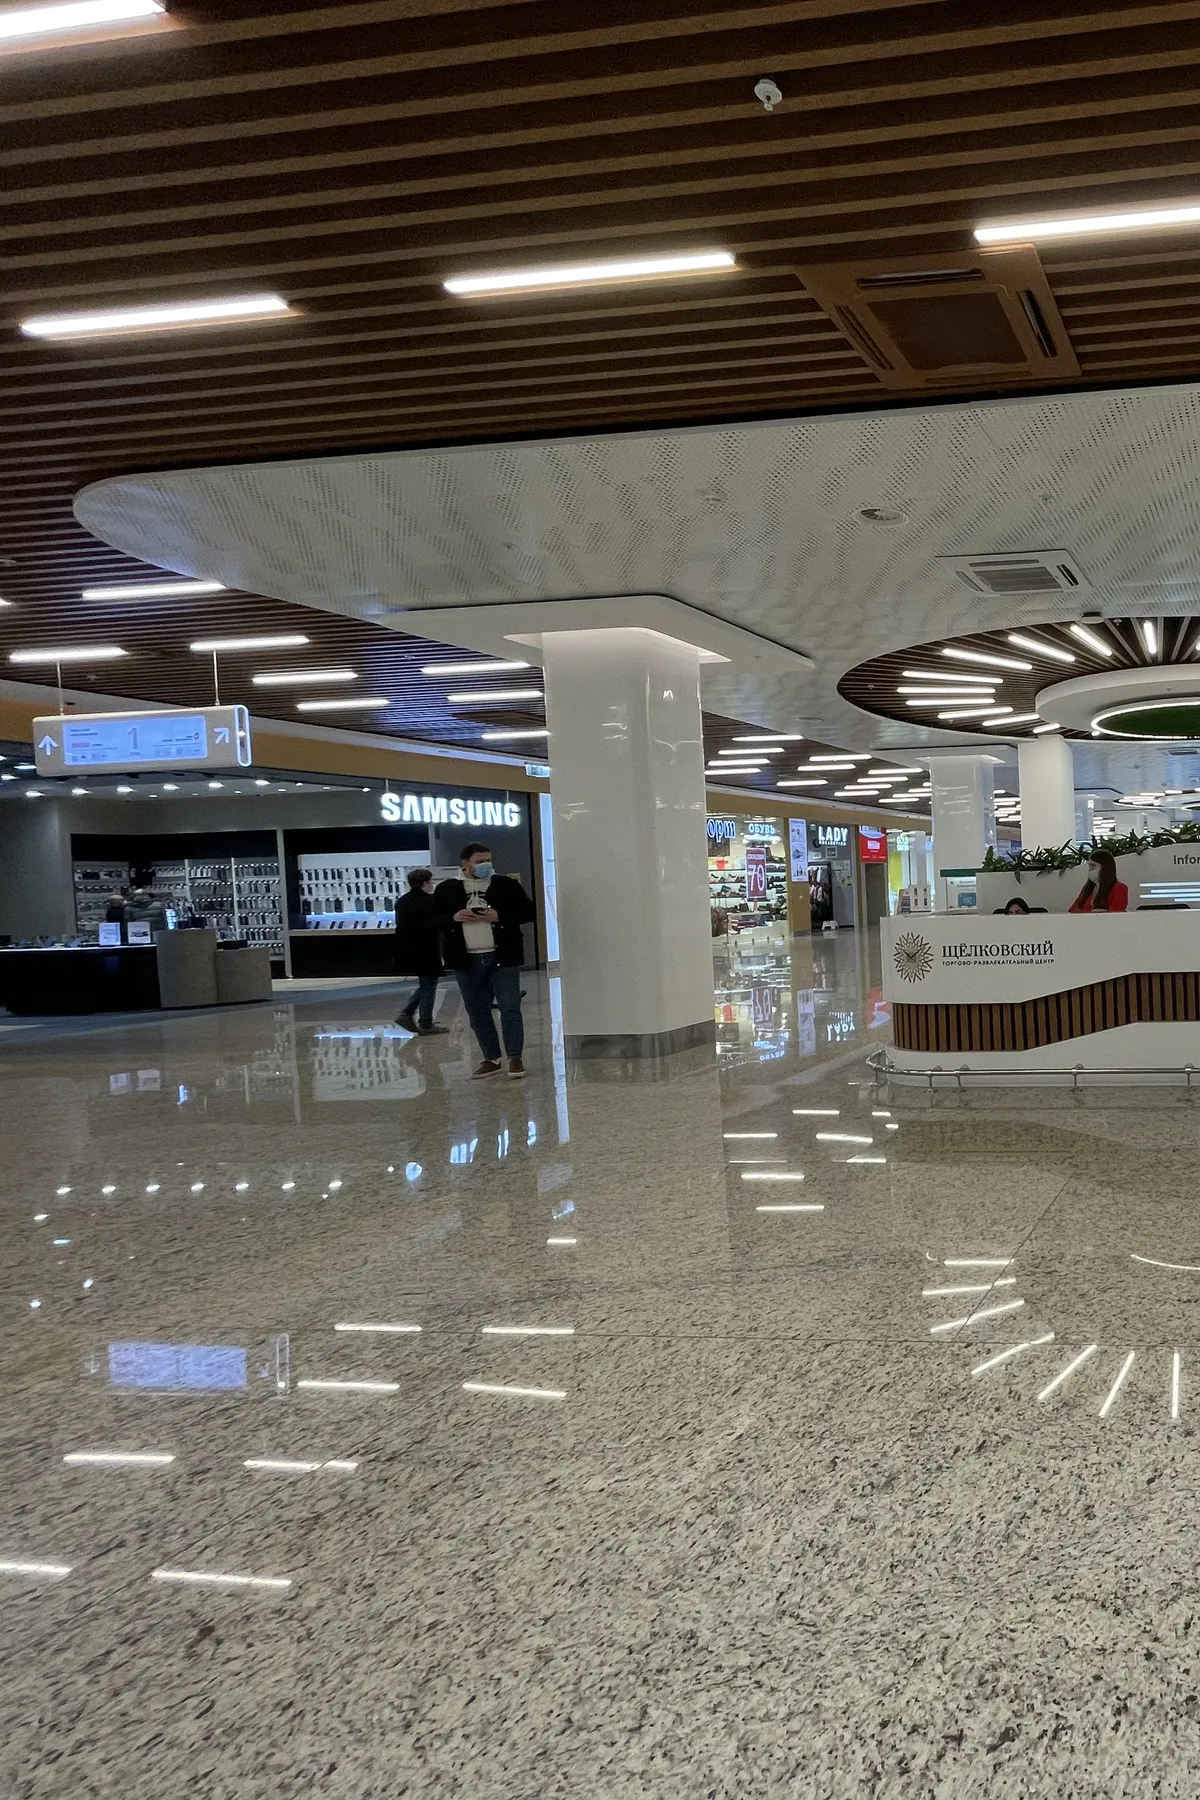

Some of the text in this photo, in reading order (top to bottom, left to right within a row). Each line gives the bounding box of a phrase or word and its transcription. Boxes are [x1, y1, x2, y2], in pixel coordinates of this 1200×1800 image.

[381, 793, 521, 827] SAMSUNG
[748, 823, 776, 834] ОБУВЬ
[818, 826, 848, 842] LADY
[942, 940, 1054, 960] ЩЁЛКОВСКИЙ
[942, 958, 1034, 966] ТОРГОВО-РАЗВЛЕКАТЕЛЬНЫЙ
